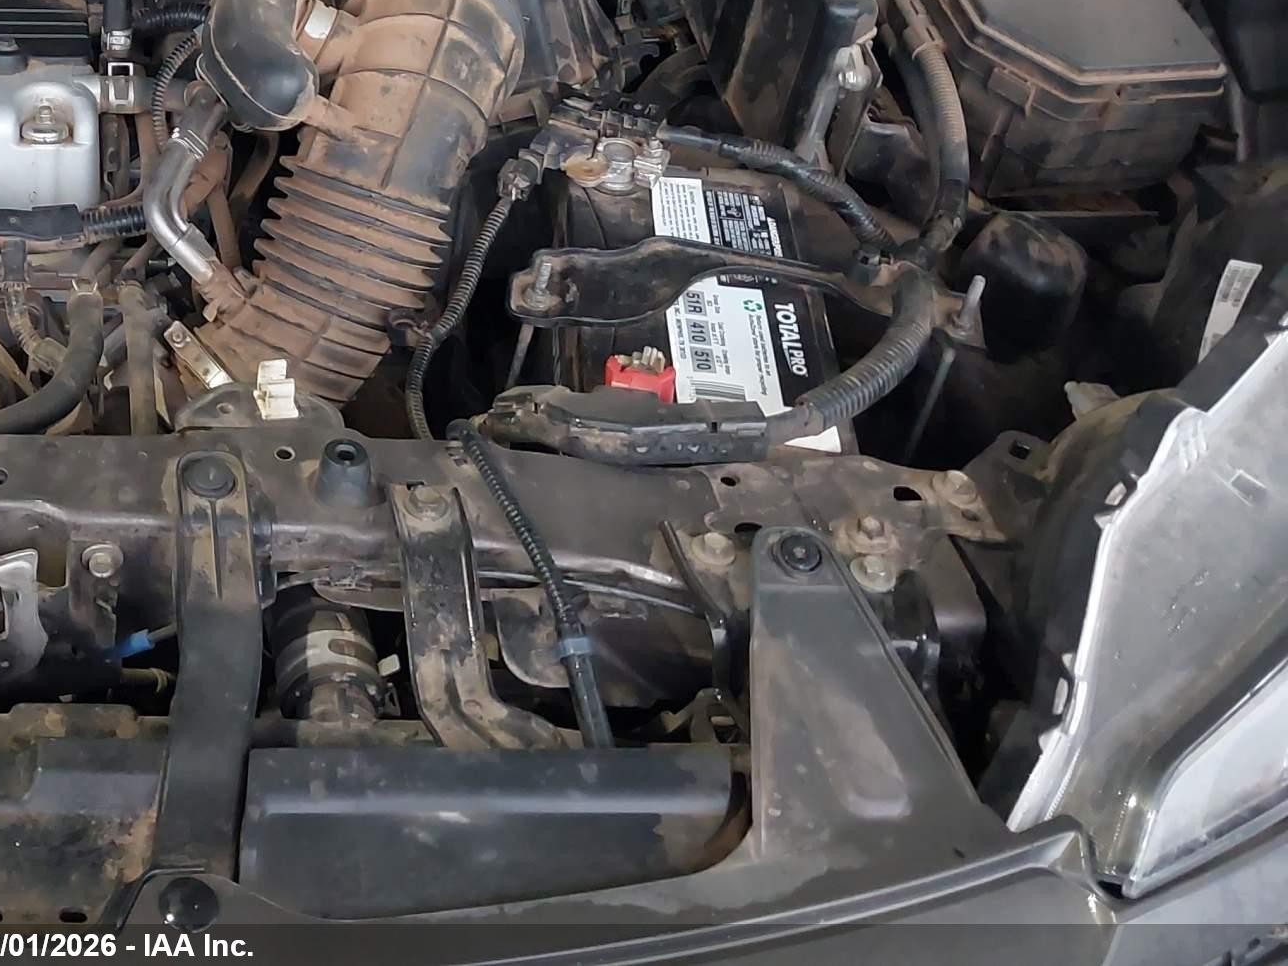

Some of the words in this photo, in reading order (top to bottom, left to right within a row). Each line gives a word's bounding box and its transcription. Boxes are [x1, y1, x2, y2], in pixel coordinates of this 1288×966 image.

[686, 292, 702, 314] 51R
[690, 321, 706, 343] 410
[694, 350, 711, 370] 510
